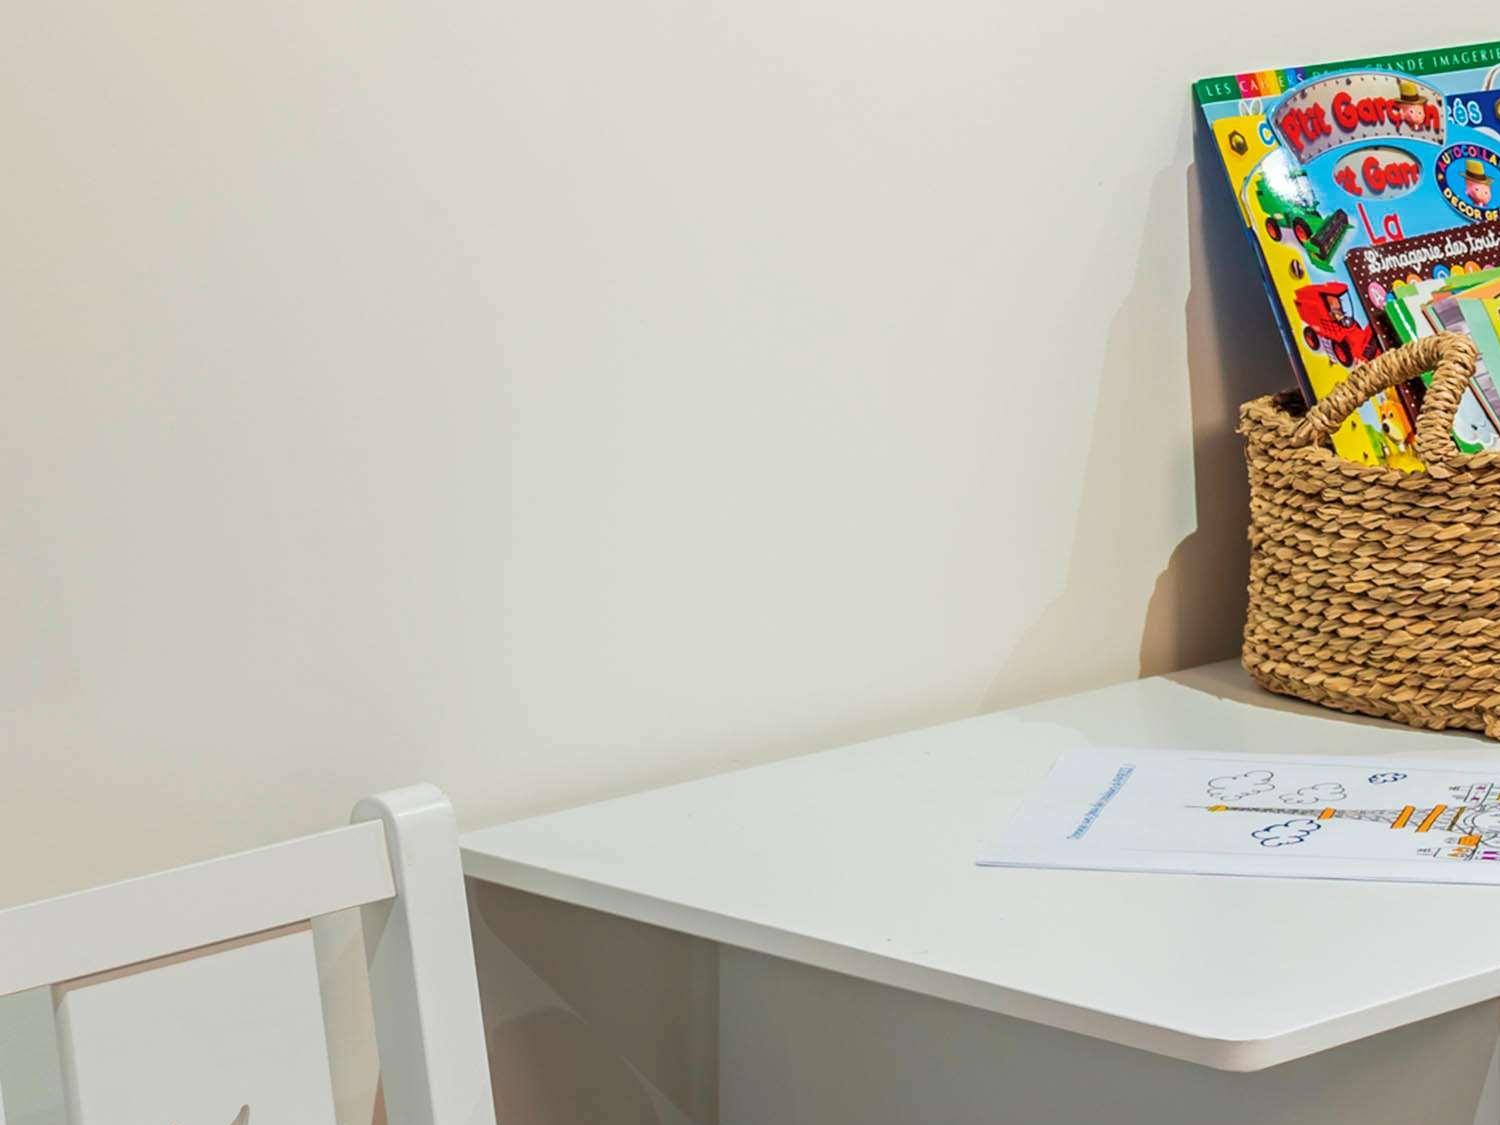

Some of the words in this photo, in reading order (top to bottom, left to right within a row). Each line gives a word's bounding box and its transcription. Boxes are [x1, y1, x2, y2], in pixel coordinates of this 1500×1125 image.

[1204, 83, 1233, 98] LES
[1357, 201, 1406, 247] La
[1444, 235, 1469, 257] des
[1465, 229, 1500, 253] tout
